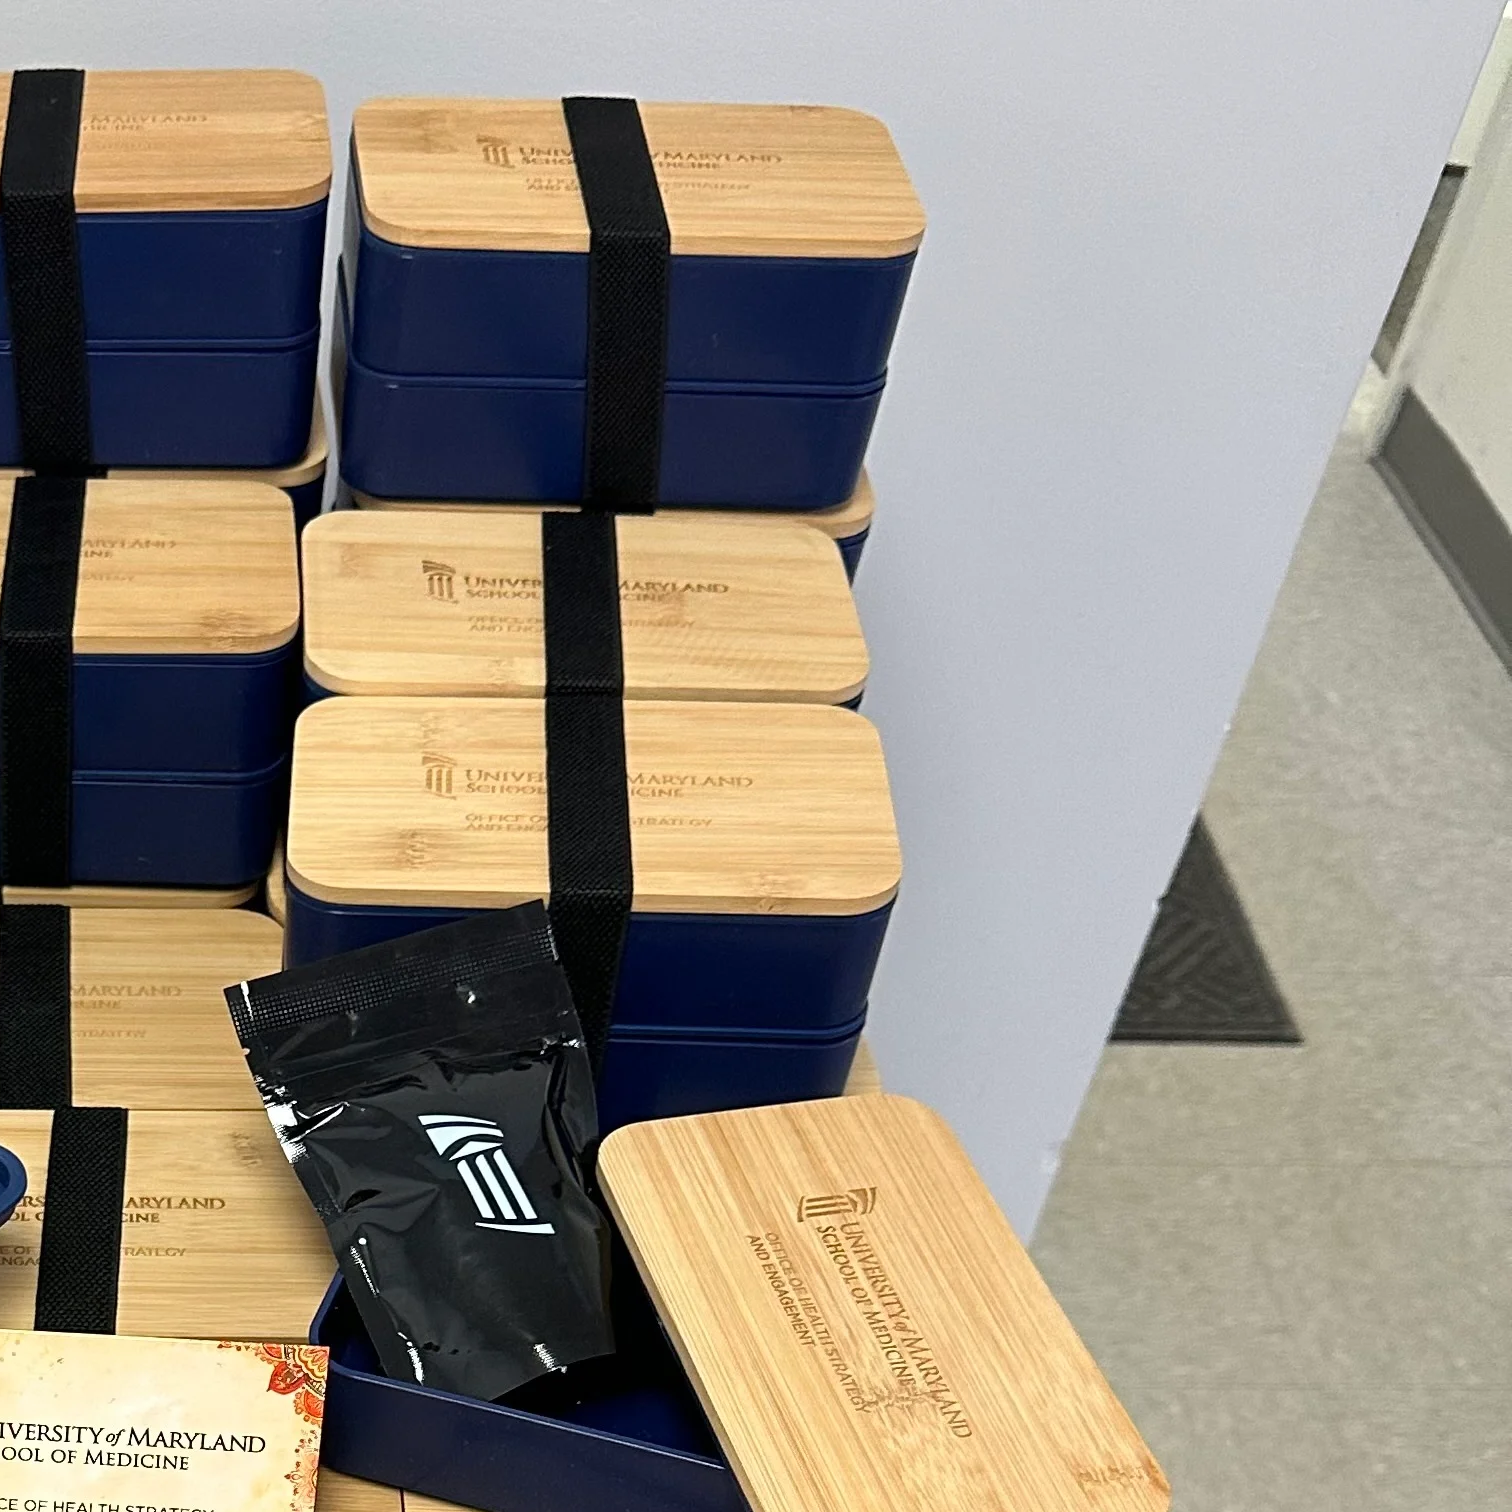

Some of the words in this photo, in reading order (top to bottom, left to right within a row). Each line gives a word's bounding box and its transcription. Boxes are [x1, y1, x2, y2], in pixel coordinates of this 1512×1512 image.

[83, 538, 177, 550] ARYLAND
[631, 788, 684, 798] ICINE
[124, 1197, 226, 1210] ARYLAND
[122, 1247, 186, 1257] RATEGY
[746, 1233, 770, 1264] AND
[762, 1262, 817, 1348] ENGAGEMENT
[817, 1225, 861, 1286] SCHOOL
[852, 1287, 873, 1308] OF
[863, 1307, 916, 1386] MEDICINE
[765, 1231, 796, 1276] OFFICE
[789, 1277, 807, 1297] OF
[825, 1343, 872, 1414] STRATEGY
[839, 1221, 910, 1324] UNIVERSITY
[901, 1331, 973, 1439] MARYLAND
[105, 1427, 125, 1447] of
[128, 1427, 266, 1454] MARYLAND
[51, 1450, 77, 1465] OF
[84, 1449, 190, 1471] MEDICINE
[25, 1499, 47, 1512] OF
